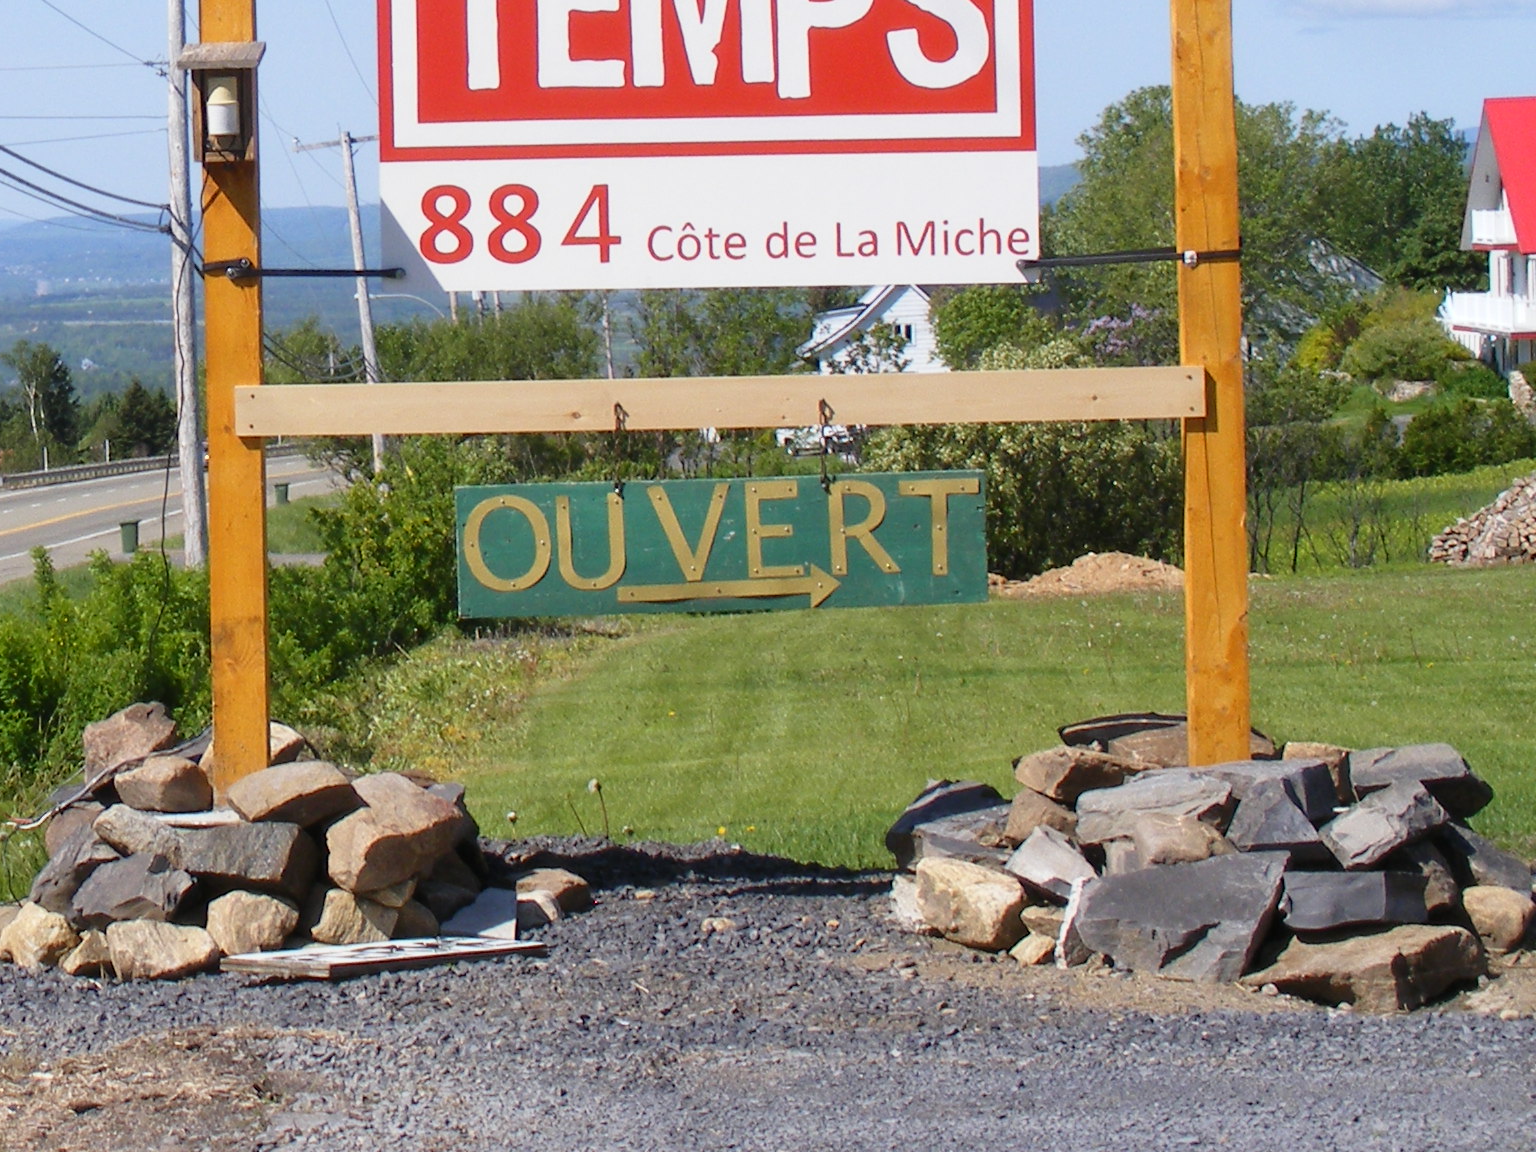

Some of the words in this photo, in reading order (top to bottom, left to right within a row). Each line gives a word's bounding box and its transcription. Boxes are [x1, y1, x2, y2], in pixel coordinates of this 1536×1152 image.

[419, 184, 622, 265] 884
[647, 221, 746, 261] Côte
[765, 221, 817, 258] de
[835, 221, 879, 257] La
[896, 218, 1031, 256] Miche
[464, 478, 980, 592] OUVERT
